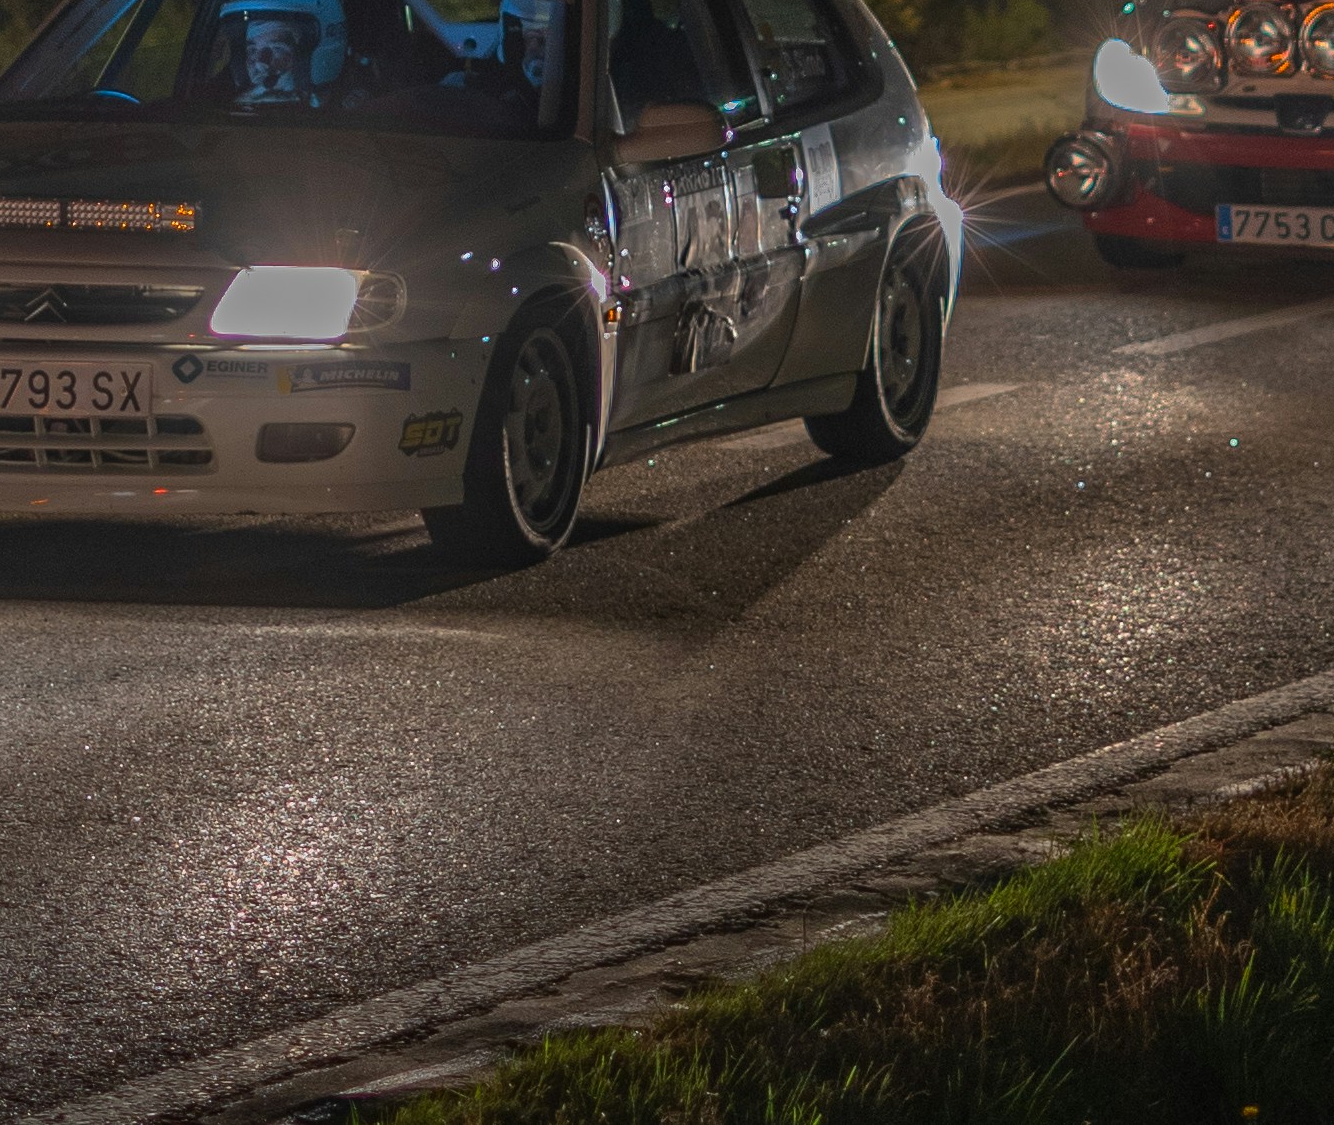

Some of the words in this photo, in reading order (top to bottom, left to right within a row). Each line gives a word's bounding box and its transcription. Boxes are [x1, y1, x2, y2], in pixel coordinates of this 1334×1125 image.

[1235, 210, 1311, 240] 7753
[206, 360, 268, 375] EGINER
[319, 368, 401, 382] MICHELIN
[92, 371, 142, 412] SX
